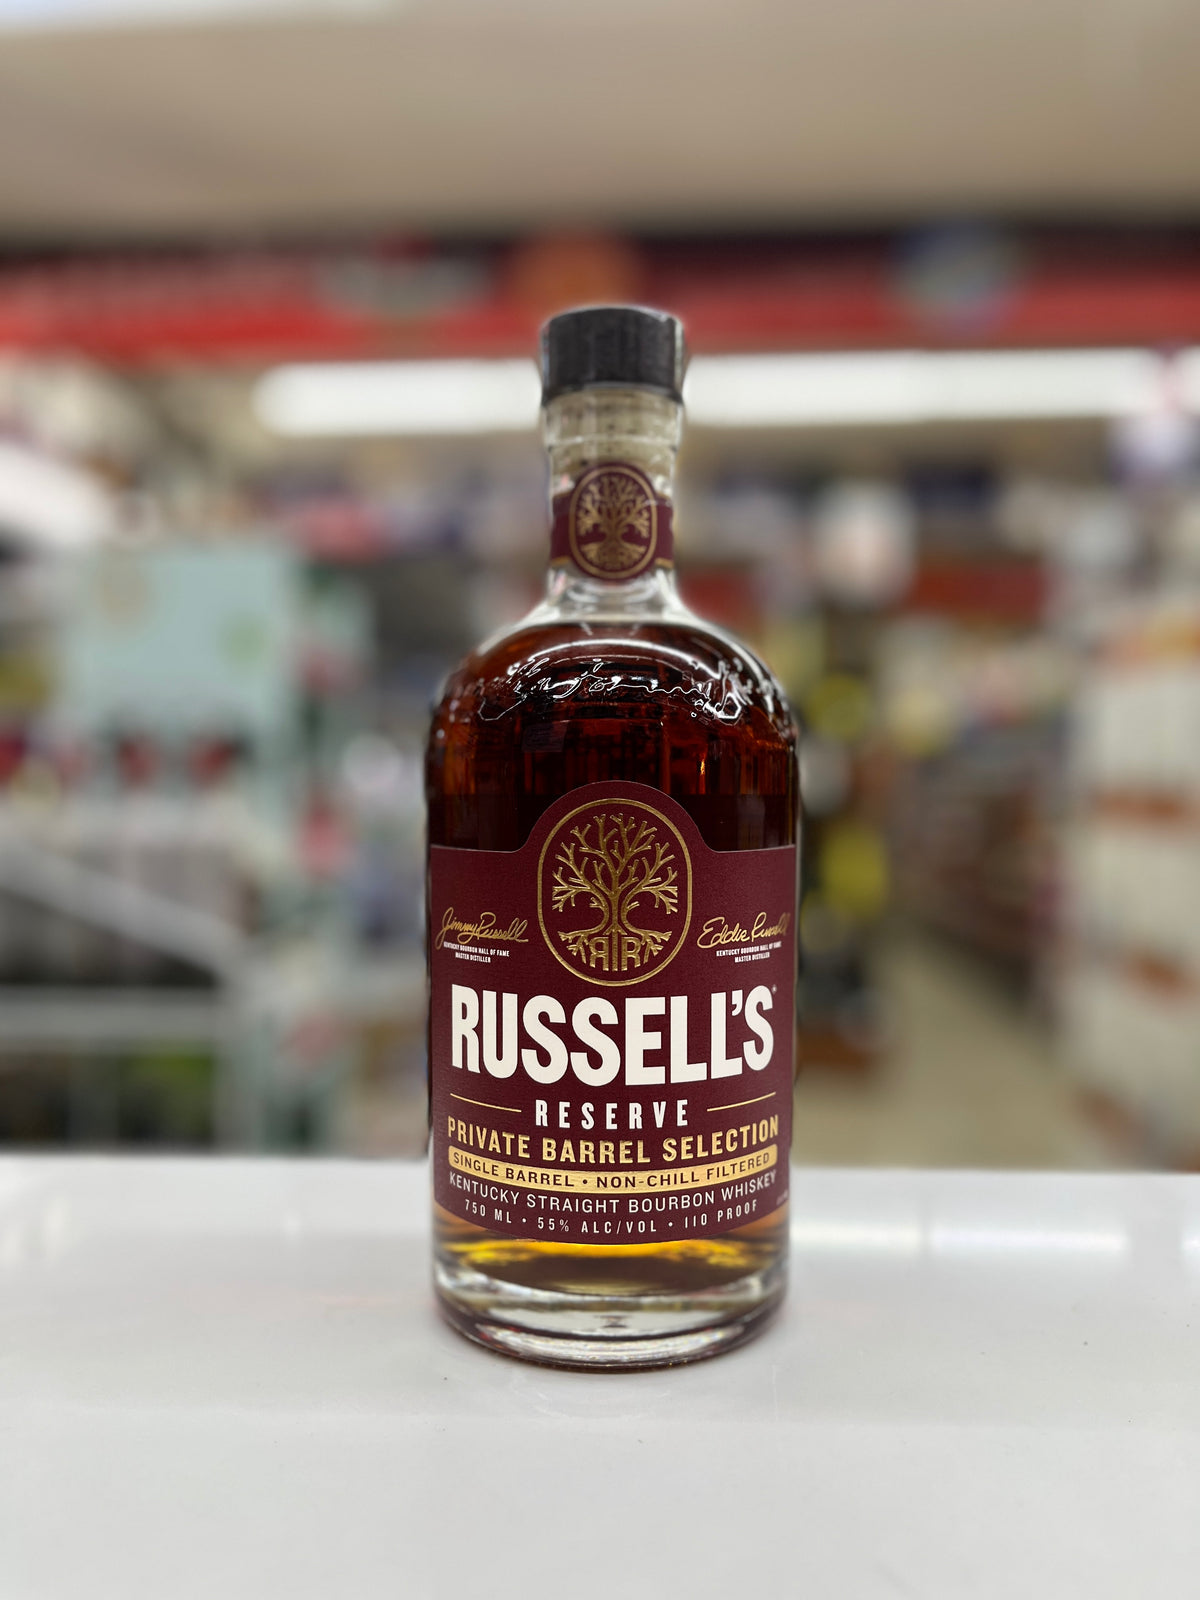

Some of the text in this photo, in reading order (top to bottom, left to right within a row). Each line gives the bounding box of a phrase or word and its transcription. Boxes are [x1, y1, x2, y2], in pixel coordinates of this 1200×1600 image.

[697, 916, 750, 949] Eddie
[455, 951, 491, 963] MASTER DISTILLER
[460, 945, 478, 953] BOURBON
[478, 947, 489, 955] HALL
[489, 948, 496, 956] OF
[496, 949, 510, 957] FAME
[716, 948, 740, 956] KENTUCKY
[741, 946, 759, 954] BOURBON
[734, 952, 770, 963] MASTER DISTILLER
[451, 984, 775, 1087] RUSSELL'S
[535, 1099, 689, 1130] RESERVE
[447, 1114, 779, 1164] PRIVATE BARREL SELECTION
[453, 1151, 770, 1188] SINGLE BARREL NON-CHILL FILTERED
[449, 1171, 520, 1205] KENTUCKY
[526, 1194, 619, 1214] STRAIGHT
[629, 1192, 715, 1214] BOURBON
[722, 1169, 776, 1202] WHISKEY
[464, 1198, 758, 1234] 750 ML 55% ALC/VOL 110 PROOF
